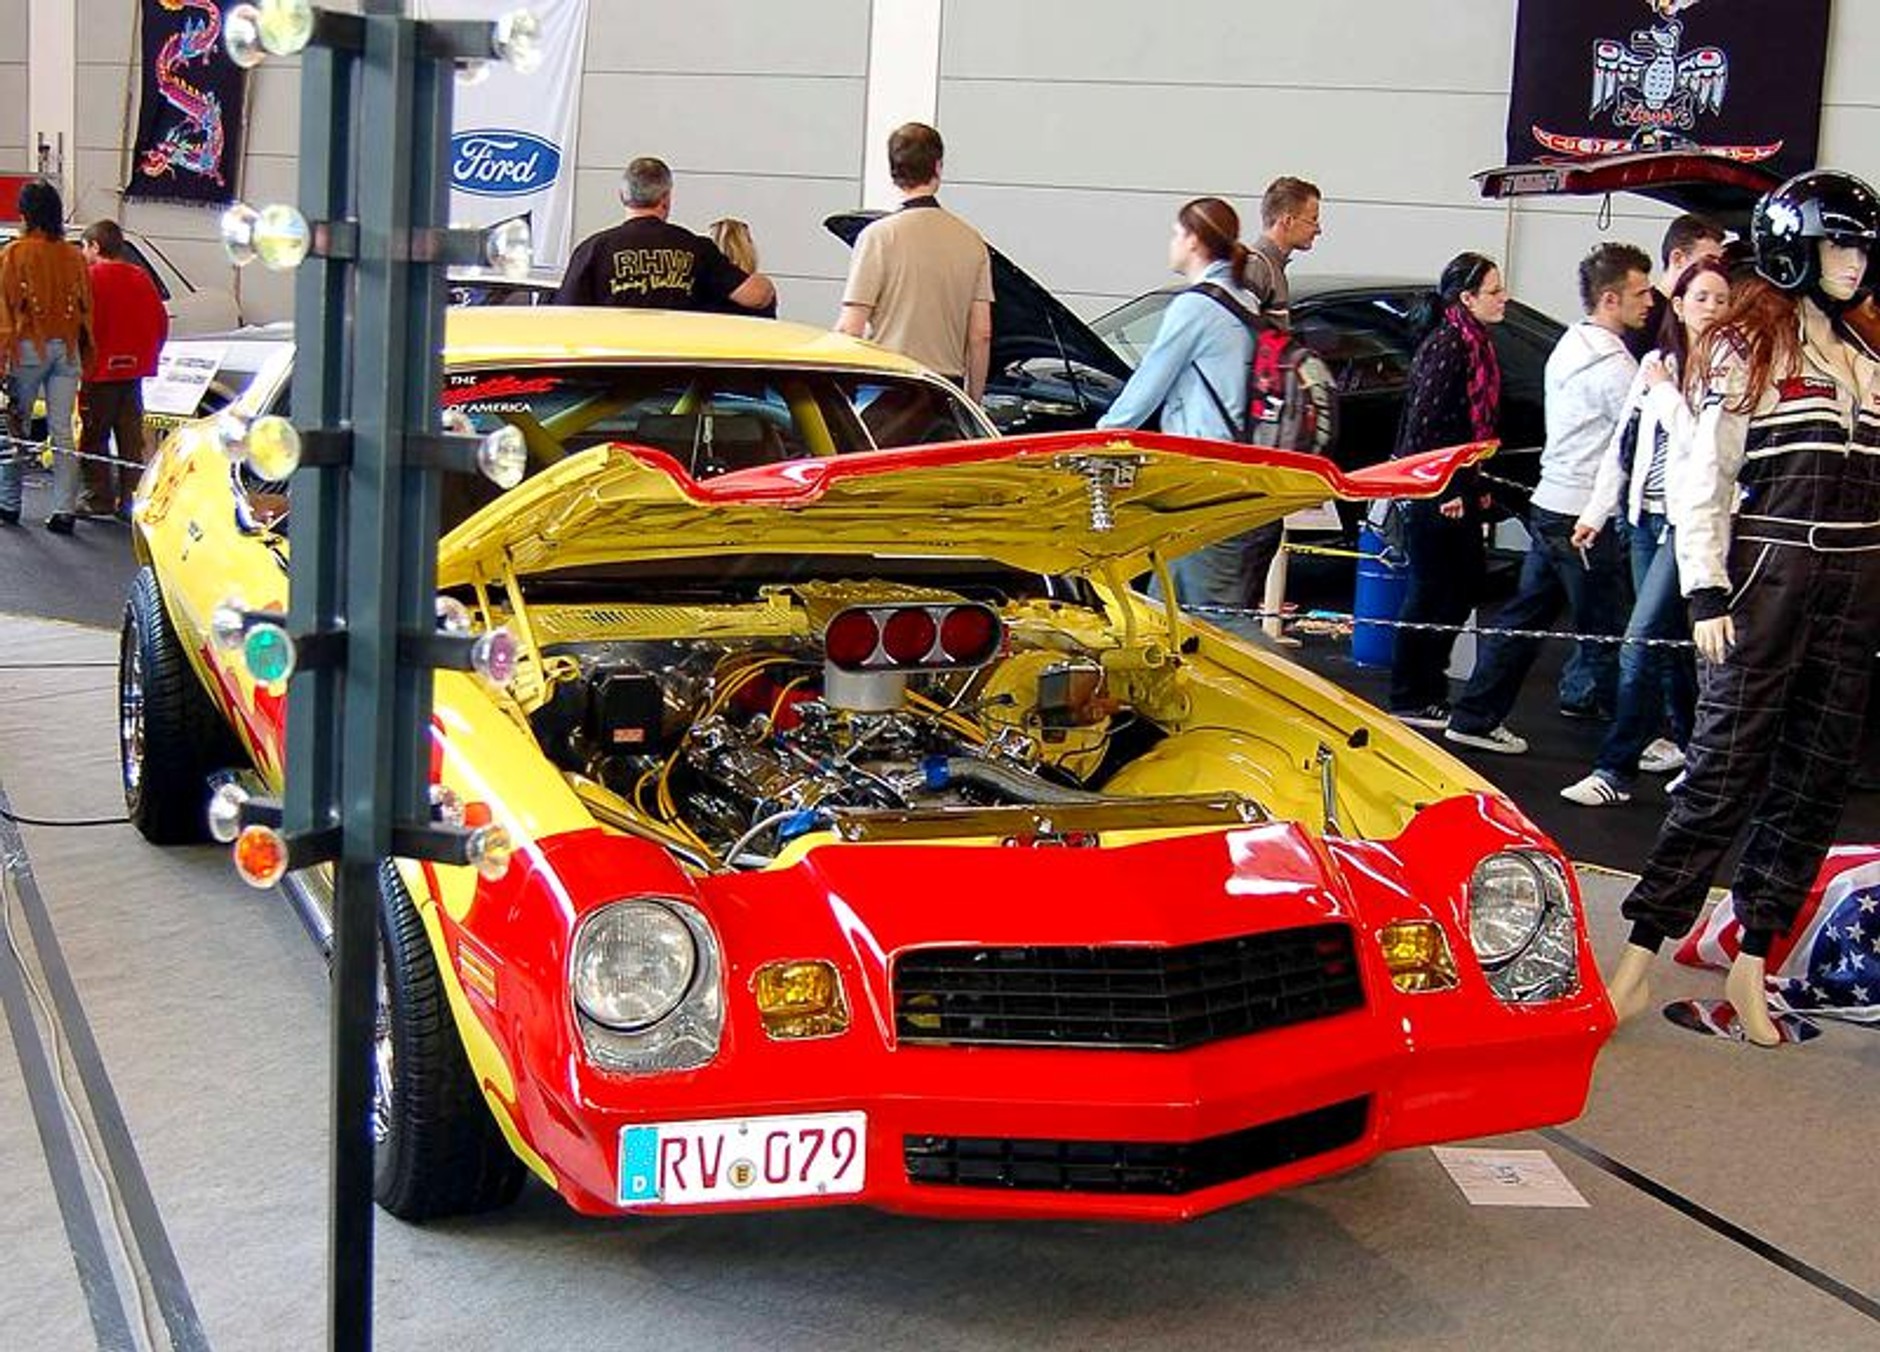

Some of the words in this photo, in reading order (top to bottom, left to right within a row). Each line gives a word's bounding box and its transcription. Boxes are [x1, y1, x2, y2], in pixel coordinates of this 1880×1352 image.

[453, 138, 539, 183] Ford
[613, 249, 695, 278] RHW
[450, 376, 478, 385] THE
[467, 402, 533, 413] AMERICA
[660, 1134, 725, 1190] RV
[764, 1126, 857, 1184] 079
[631, 1174, 648, 1193] D
